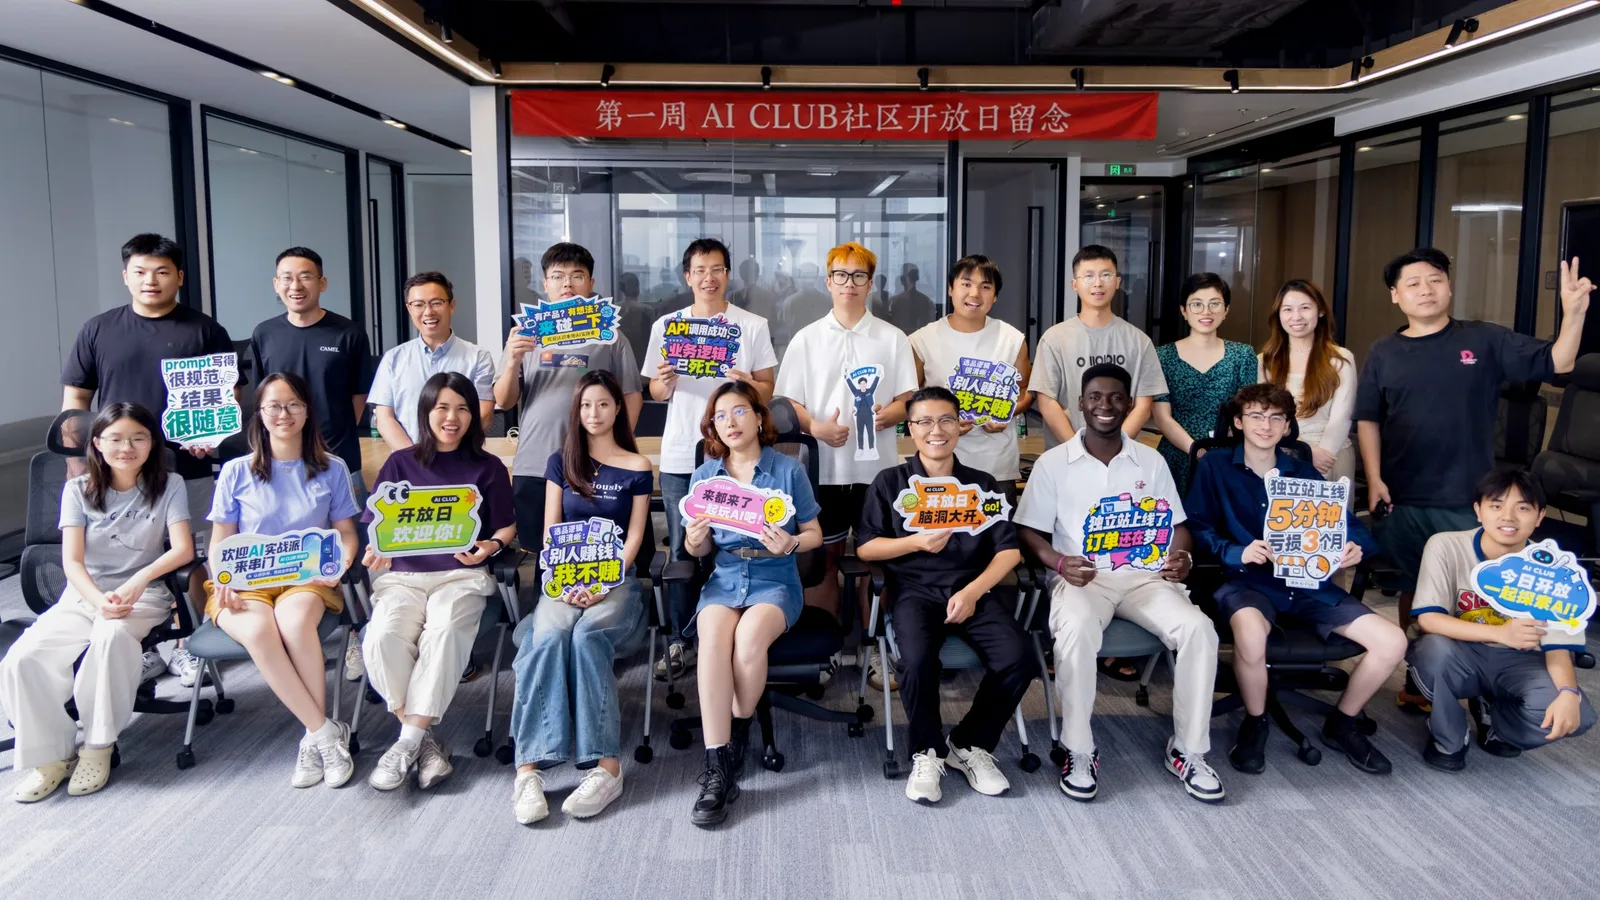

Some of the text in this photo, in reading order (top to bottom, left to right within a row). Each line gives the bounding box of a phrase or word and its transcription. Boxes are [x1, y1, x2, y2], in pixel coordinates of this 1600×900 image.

[595, 99, 1071, 133] 第一周 AI CLUB社区开放日留念
[539, 313, 602, 335] 来碰一下
[668, 343, 728, 361] 业务逻辑
[165, 355, 235, 372] prompt写得
[676, 359, 719, 377] 已死亡
[169, 369, 224, 387] 很规范，
[952, 375, 1011, 399] 别人赚钱
[181, 388, 222, 408] 结果
[955, 390, 1013, 419] 我不赚
[165, 406, 239, 438] 很随意
[591, 481, 623, 492] iously
[1270, 480, 1345, 500] 独立站上线
[702, 489, 753, 509] 来都来了
[926, 494, 968, 508] 开放日
[984, 501, 1000, 512] GO!
[397, 506, 452, 523] 开放日
[918, 509, 977, 524] 脑洞大开
[392, 523, 463, 542] 欢迎你！
[554, 524, 583, 535] 选品逻辑
[1086, 528, 1169, 552] 订单还在梦里
[1268, 530, 1343, 552] 亏损3个月
[221, 540, 300, 562] 欢迎AI实战派
[549, 544, 613, 565] 别人赚钱
[234, 556, 275, 574] 来串门
[554, 559, 621, 586] 我不赚
[1533, 568, 1555, 578] CLUB
[1500, 569, 1572, 599] 今日开放
